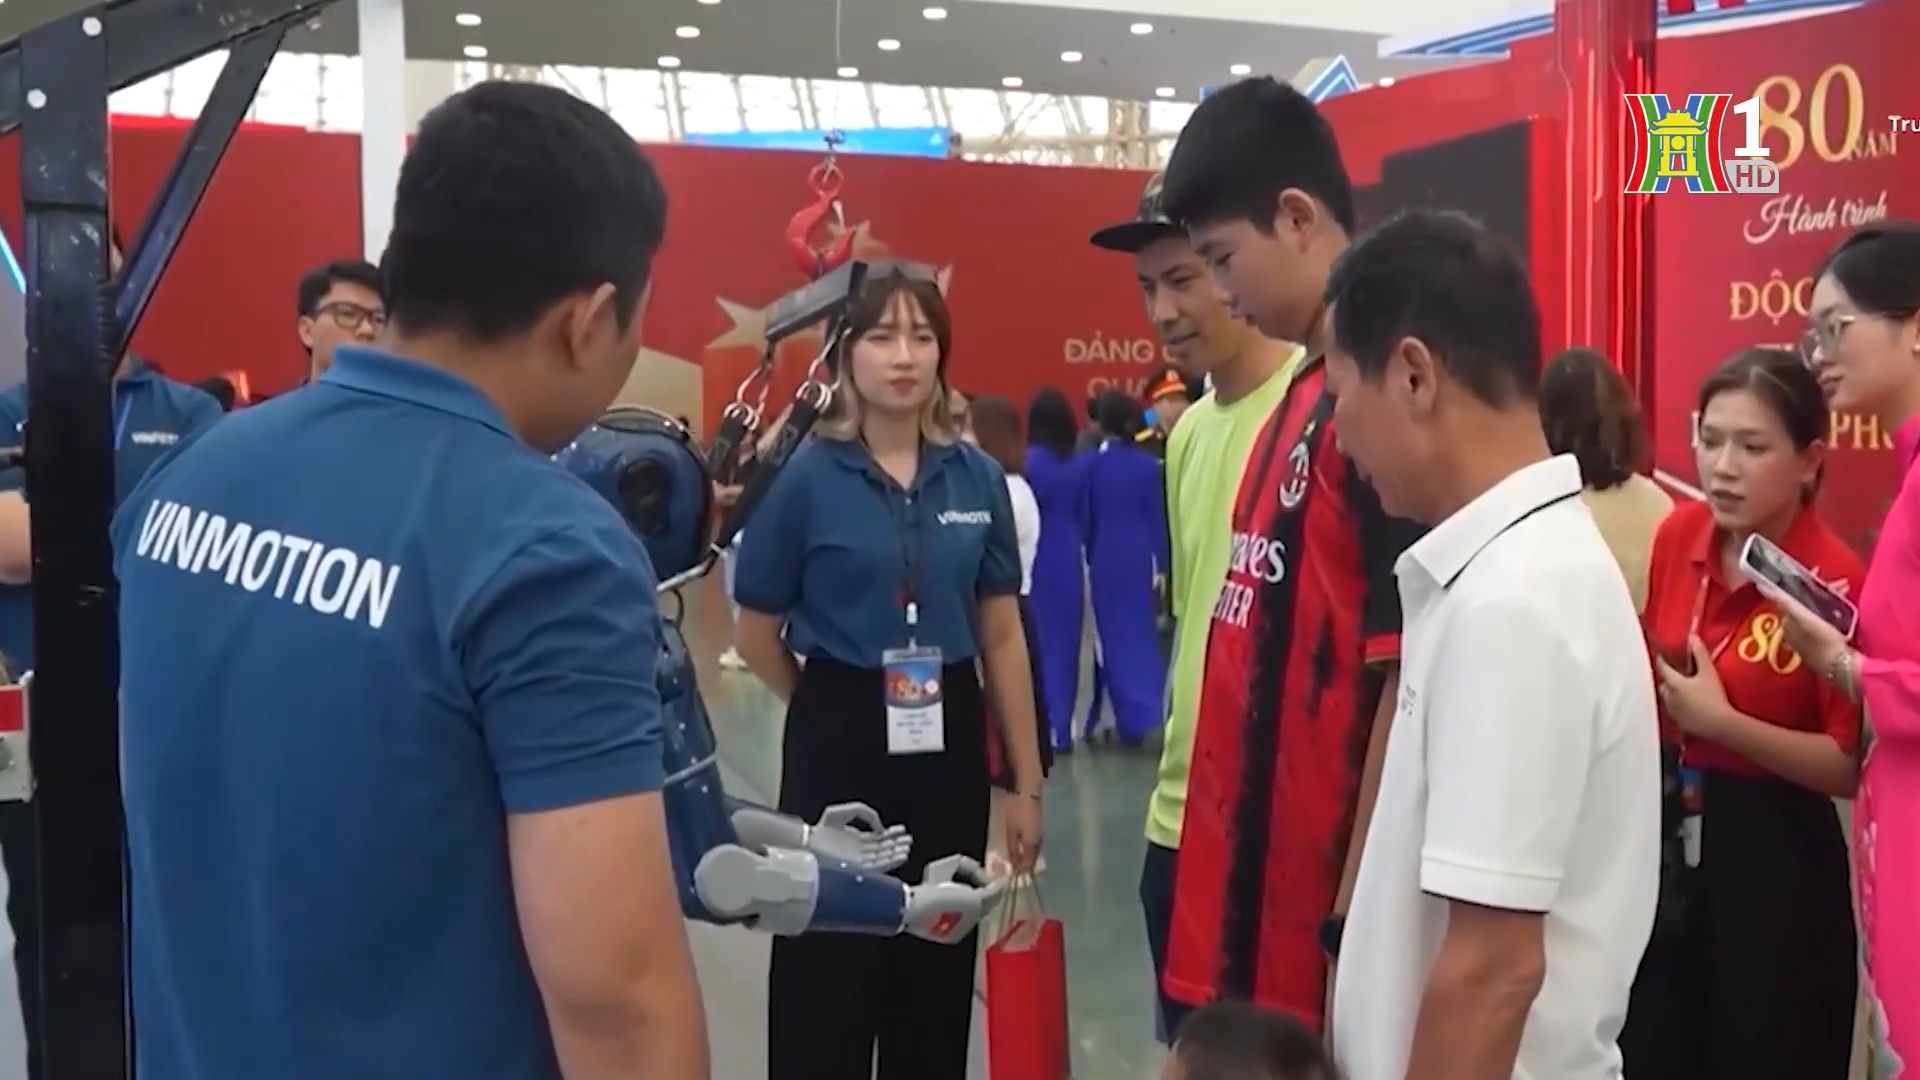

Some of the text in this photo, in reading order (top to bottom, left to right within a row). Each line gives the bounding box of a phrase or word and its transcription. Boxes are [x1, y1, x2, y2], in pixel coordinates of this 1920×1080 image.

[1748, 64, 1864, 171] 80
[1744, 194, 1836, 244] Hành
[1064, 330, 1155, 363] ĐẢNG
[1827, 411, 1895, 450] PH
[136, 499, 400, 629] VINMOTION
